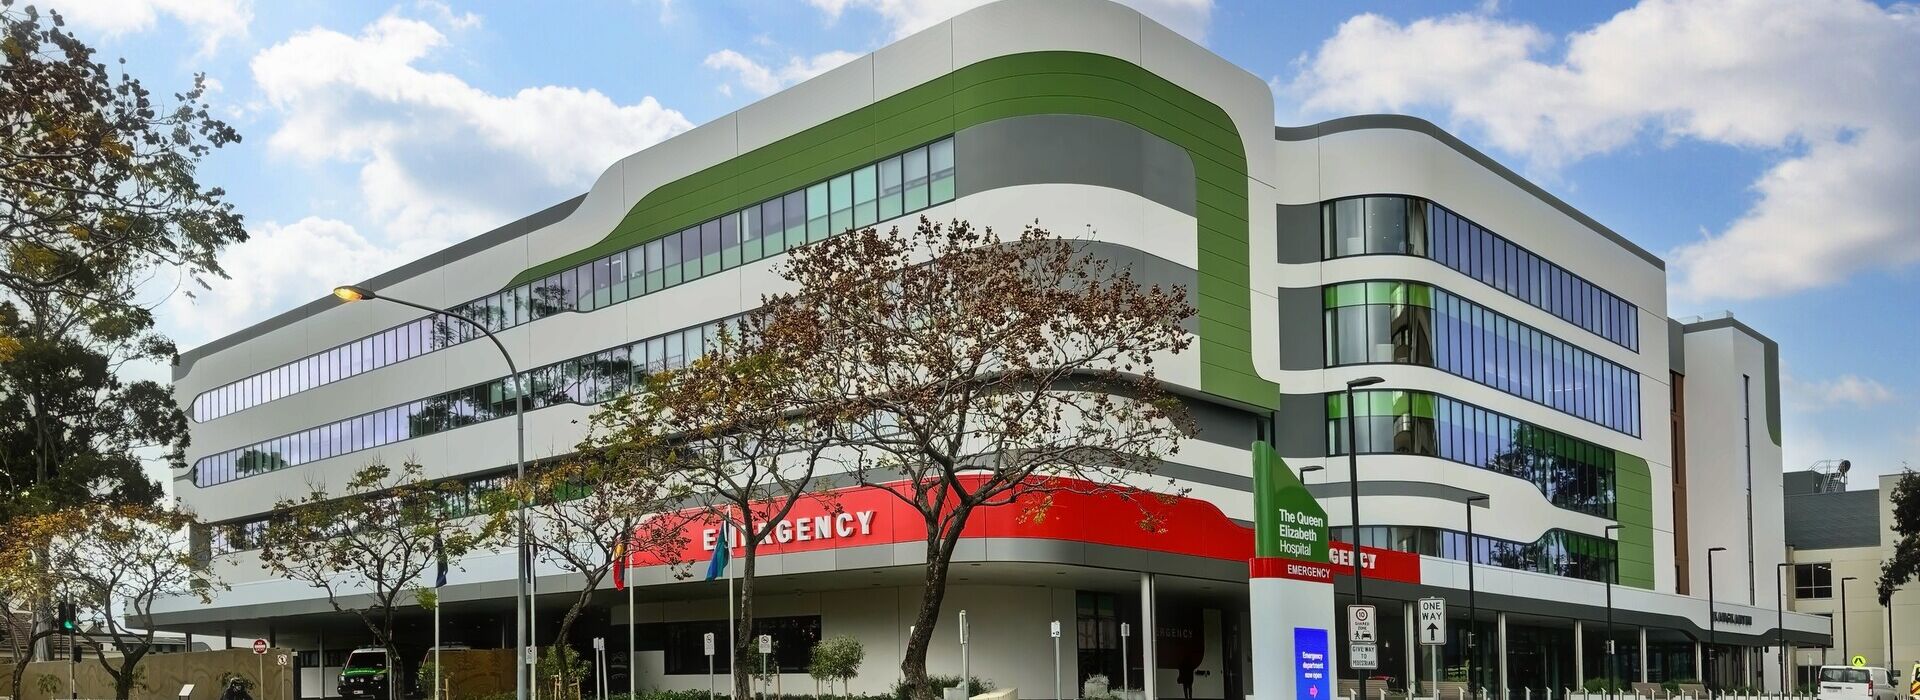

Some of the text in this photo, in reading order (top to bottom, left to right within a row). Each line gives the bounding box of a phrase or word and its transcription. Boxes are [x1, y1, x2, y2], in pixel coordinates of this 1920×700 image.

[1279, 508, 1324, 528] The Queen
[703, 511, 874, 551] ERGENCY
[1279, 524, 1317, 542] Elizabeth
[1279, 540, 1312, 557] Hospital
[1329, 549, 1376, 569] GENCY
[1287, 564, 1331, 578] EMERGENCY
[1423, 602, 1441, 610] ONE
[1422, 612, 1442, 620] WAY
[1302, 651, 1323, 661] Emergency
